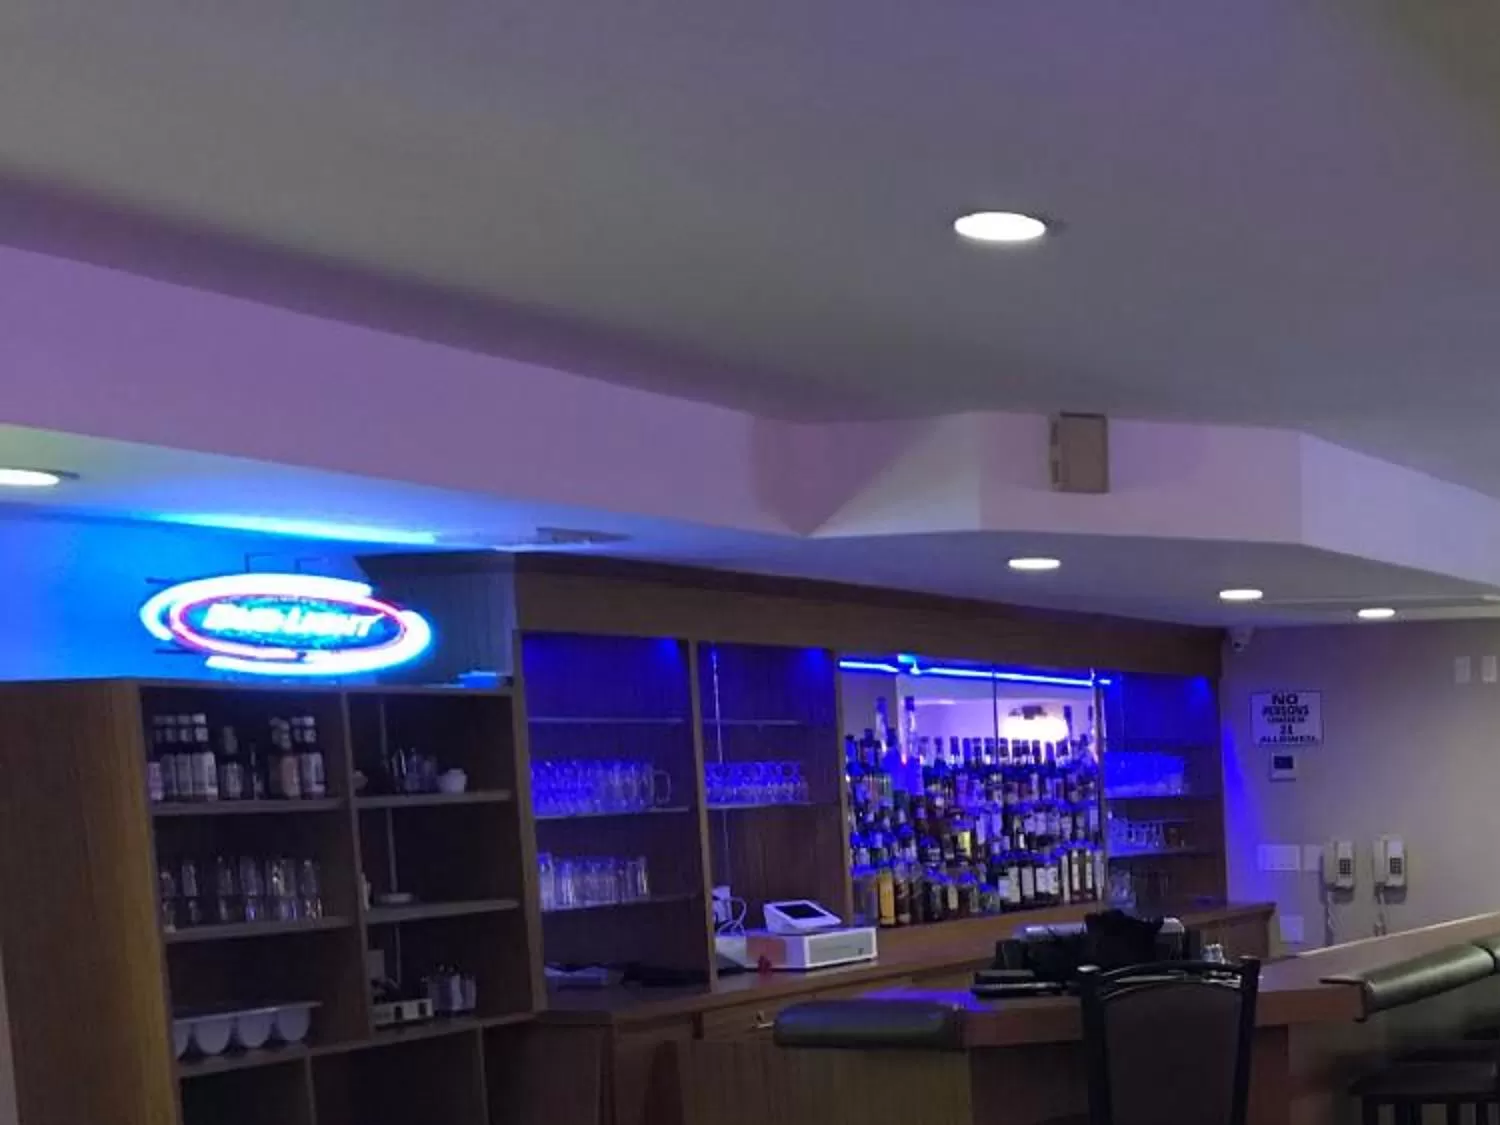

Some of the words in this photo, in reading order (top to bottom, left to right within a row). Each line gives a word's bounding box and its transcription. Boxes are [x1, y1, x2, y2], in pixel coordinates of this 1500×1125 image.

[1271, 693, 1298, 704] NO
[1262, 705, 1309, 716] PERSONS
[1279, 724, 1294, 735] 21
